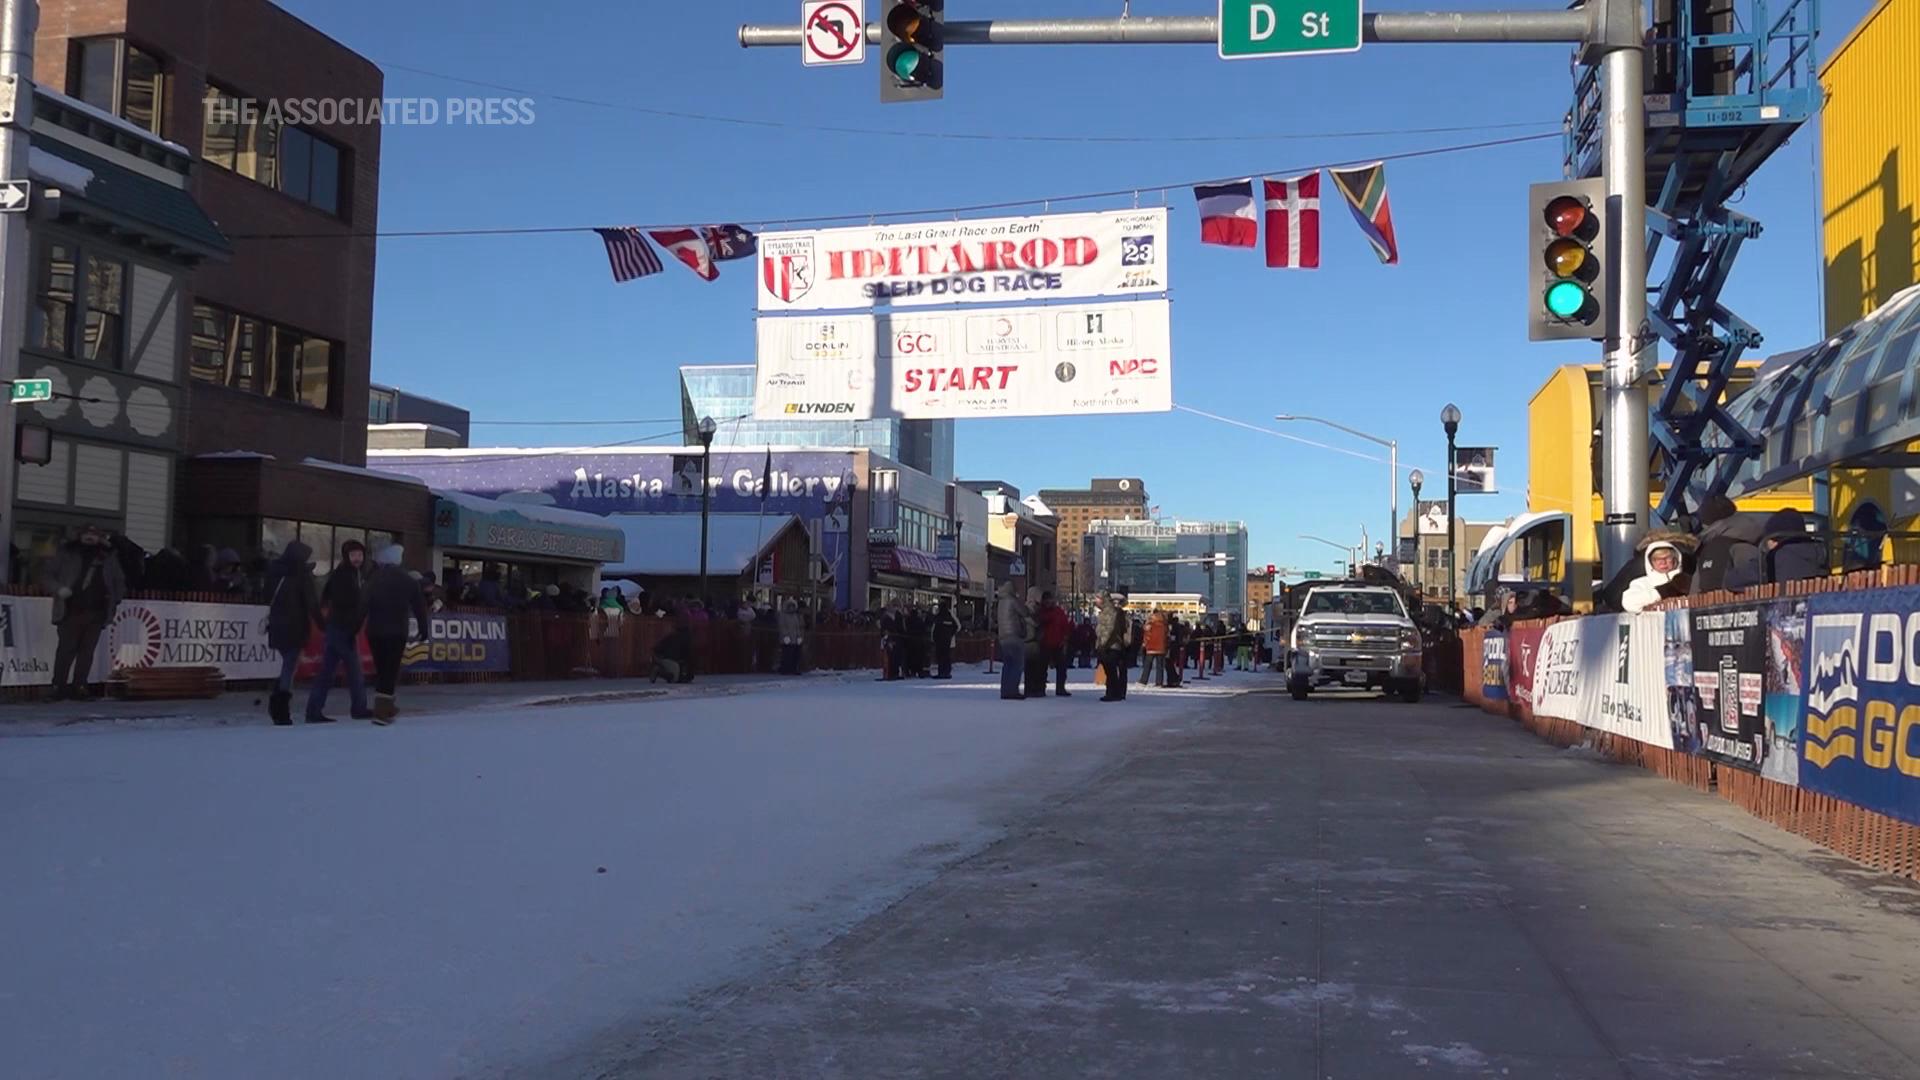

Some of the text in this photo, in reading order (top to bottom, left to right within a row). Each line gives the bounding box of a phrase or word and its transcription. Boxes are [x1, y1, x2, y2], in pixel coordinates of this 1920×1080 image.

[1250, 4, 1330, 40] D St
[874, 222, 1040, 241] The Last Great Race on Earth
[826, 235, 1099, 280] IDITAROD
[862, 271, 1063, 298] SLED DOG RACE
[896, 333, 938, 354] GCI
[904, 365, 1019, 393] START
[19, 384, 26, 396] D
[798, 402, 855, 414] LYNDEN
[569, 467, 664, 499] Alaska
[732, 468, 845, 502] Gallery
[488, 525, 537, 549] SARA'S
[164, 618, 248, 640] HARVEST
[431, 619, 506, 640] DONLIN
[161, 644, 277, 663] MIDSTREAM
[431, 642, 486, 662] GOLD
[8, 657, 49, 672] Alaska
